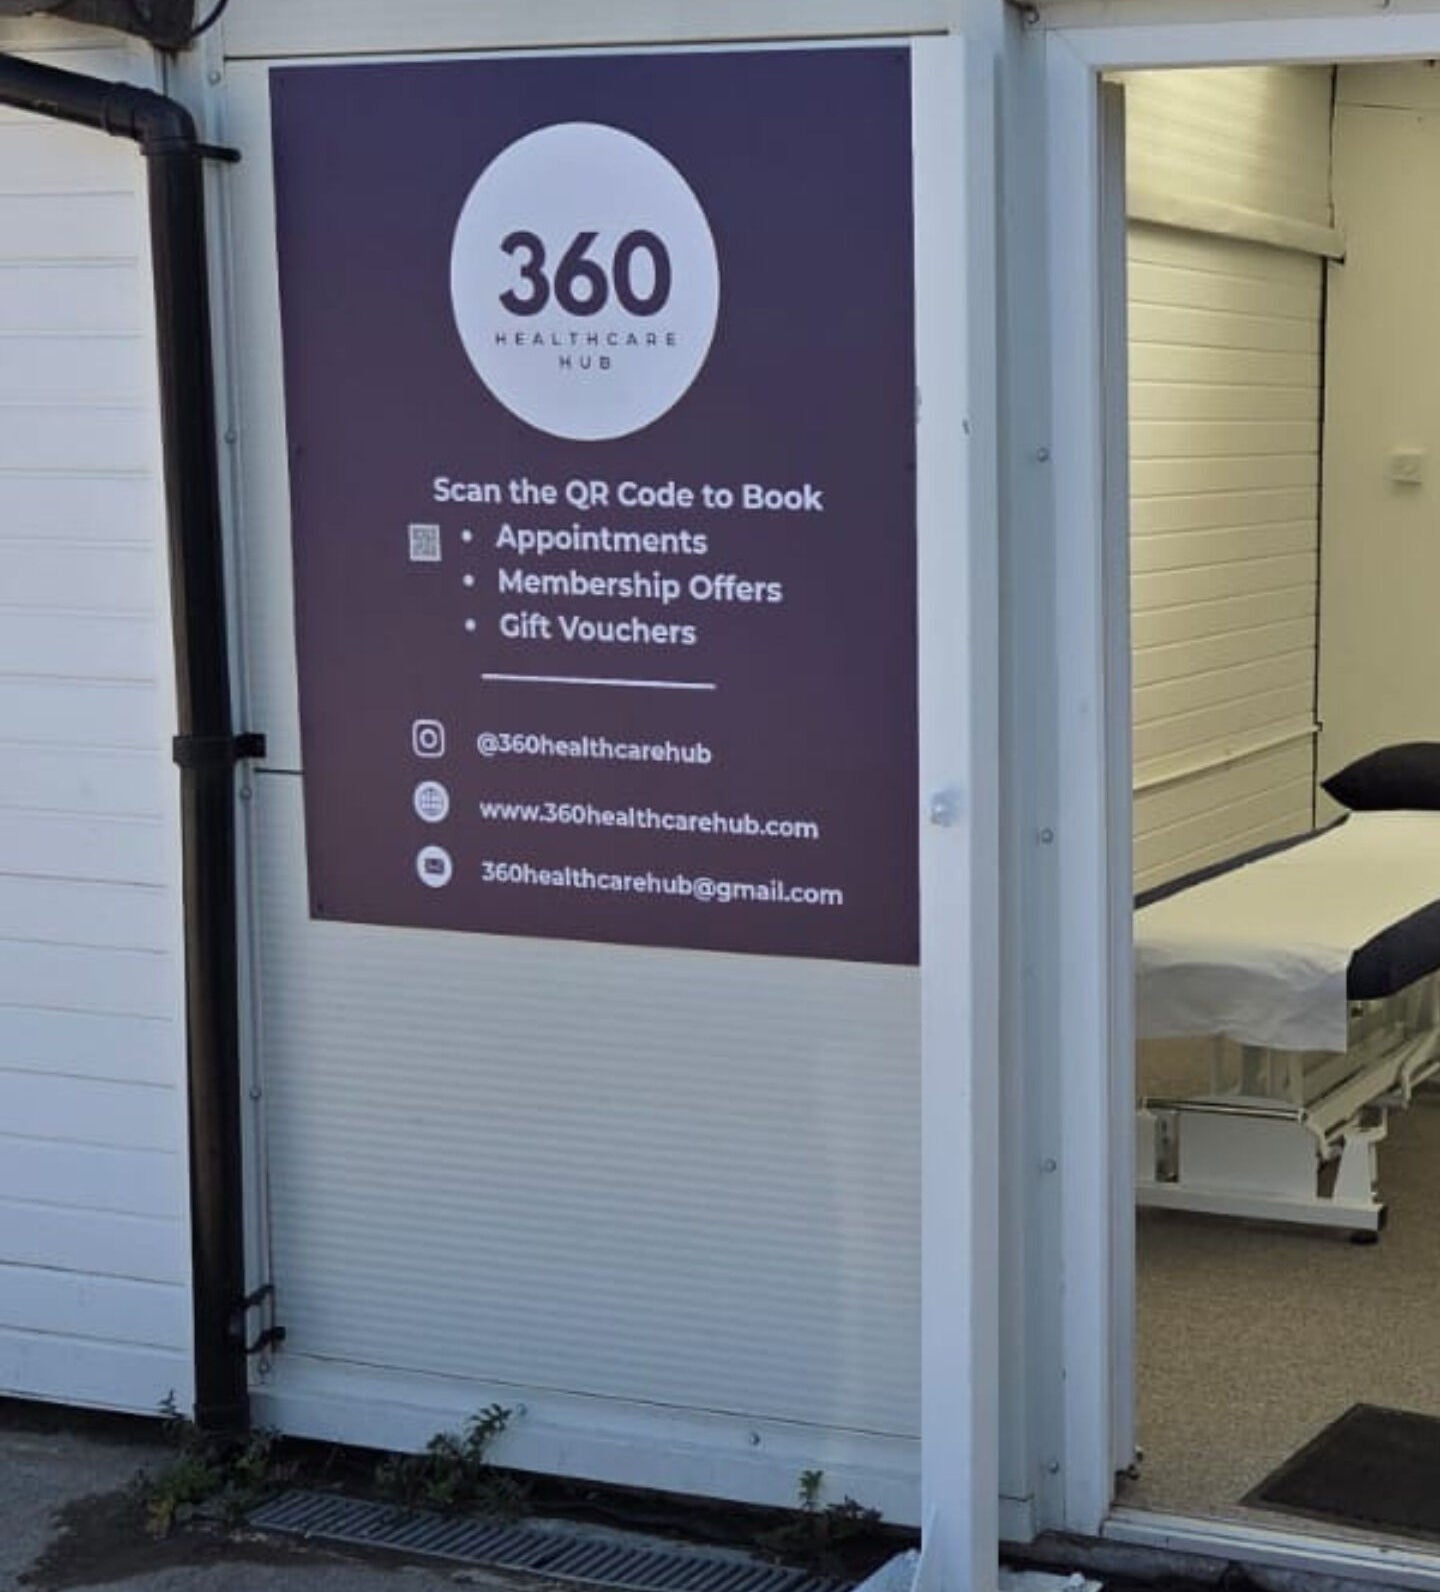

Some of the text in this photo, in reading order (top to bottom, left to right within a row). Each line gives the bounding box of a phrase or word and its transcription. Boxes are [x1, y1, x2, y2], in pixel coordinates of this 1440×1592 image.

[499, 229, 672, 317] 360
[495, 331, 678, 347] HEALTHCARE
[559, 355, 612, 371] HUB
[433, 476, 824, 511] Scan the QR Code to Book
[496, 523, 708, 555] Appointments
[498, 568, 783, 605] Membership Offers
[500, 611, 697, 645] Gift Vouchers
[477, 733, 712, 764] @360healthcarehub
[479, 803, 820, 839] www.360healthcarehub.com
[481, 861, 844, 906] 360healthcarehub@gmail.com
